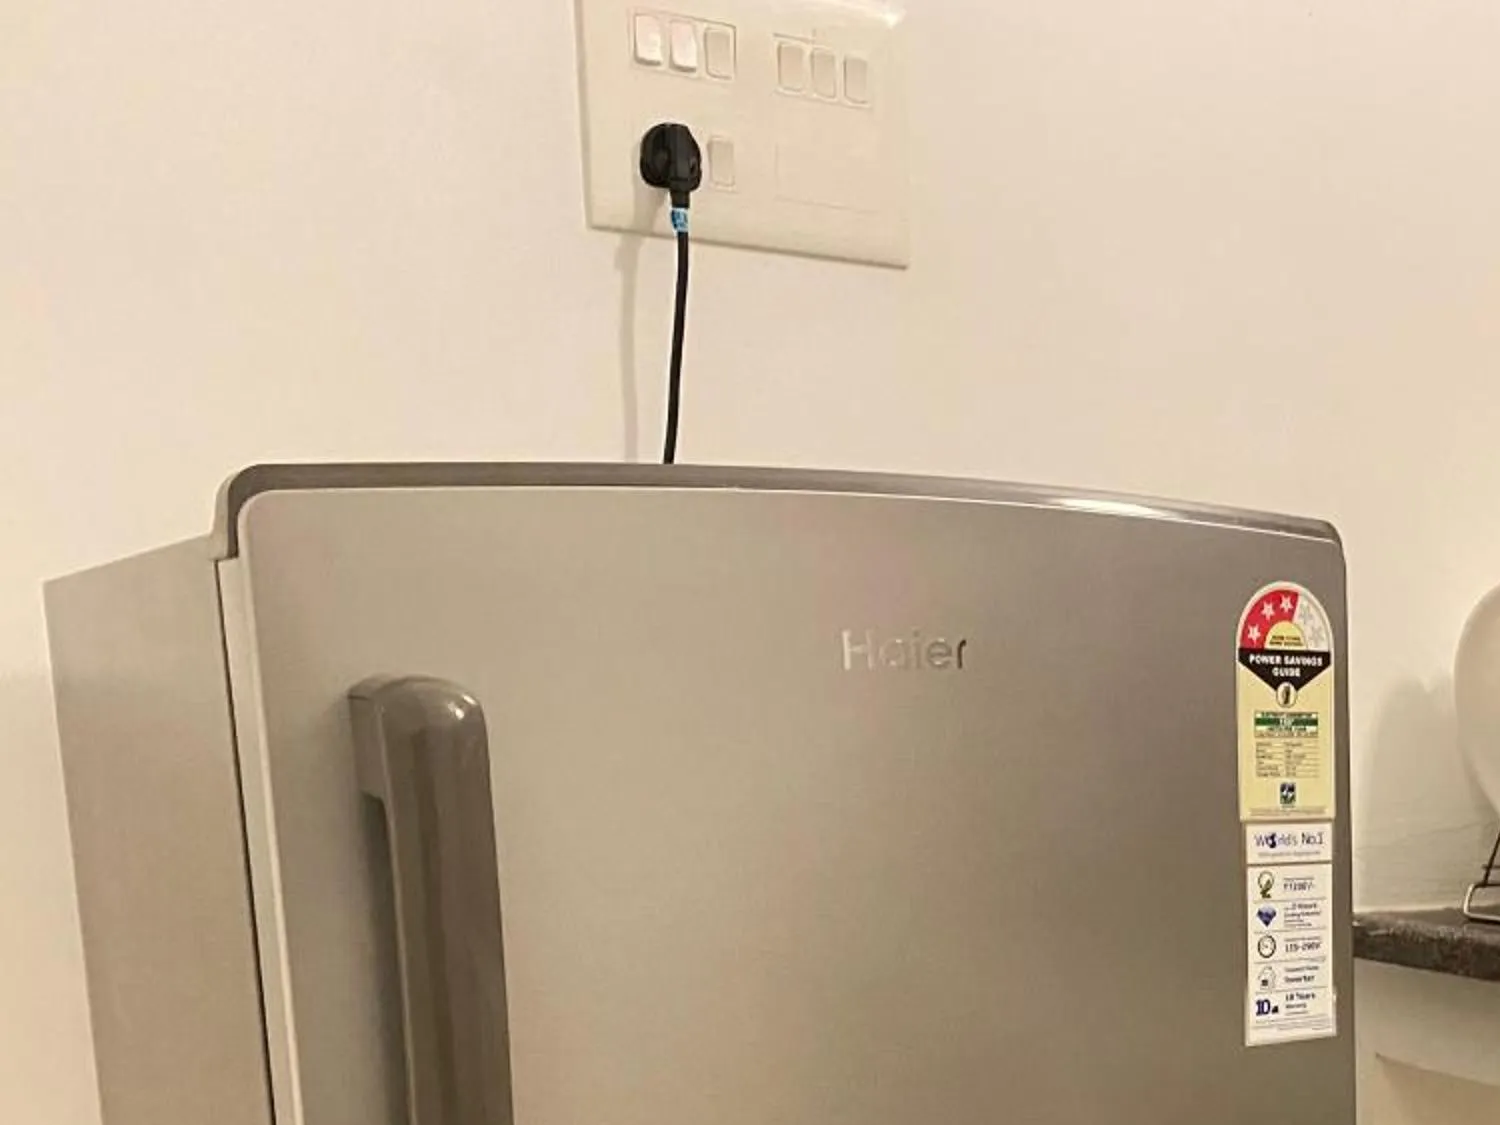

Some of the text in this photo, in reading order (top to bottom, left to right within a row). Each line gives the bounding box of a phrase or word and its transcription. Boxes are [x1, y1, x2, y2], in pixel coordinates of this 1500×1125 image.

[841, 629, 967, 671] Haier
[1249, 653, 1323, 667] POWER SAVINGS
[1271, 667, 1301, 677] GUIDE
